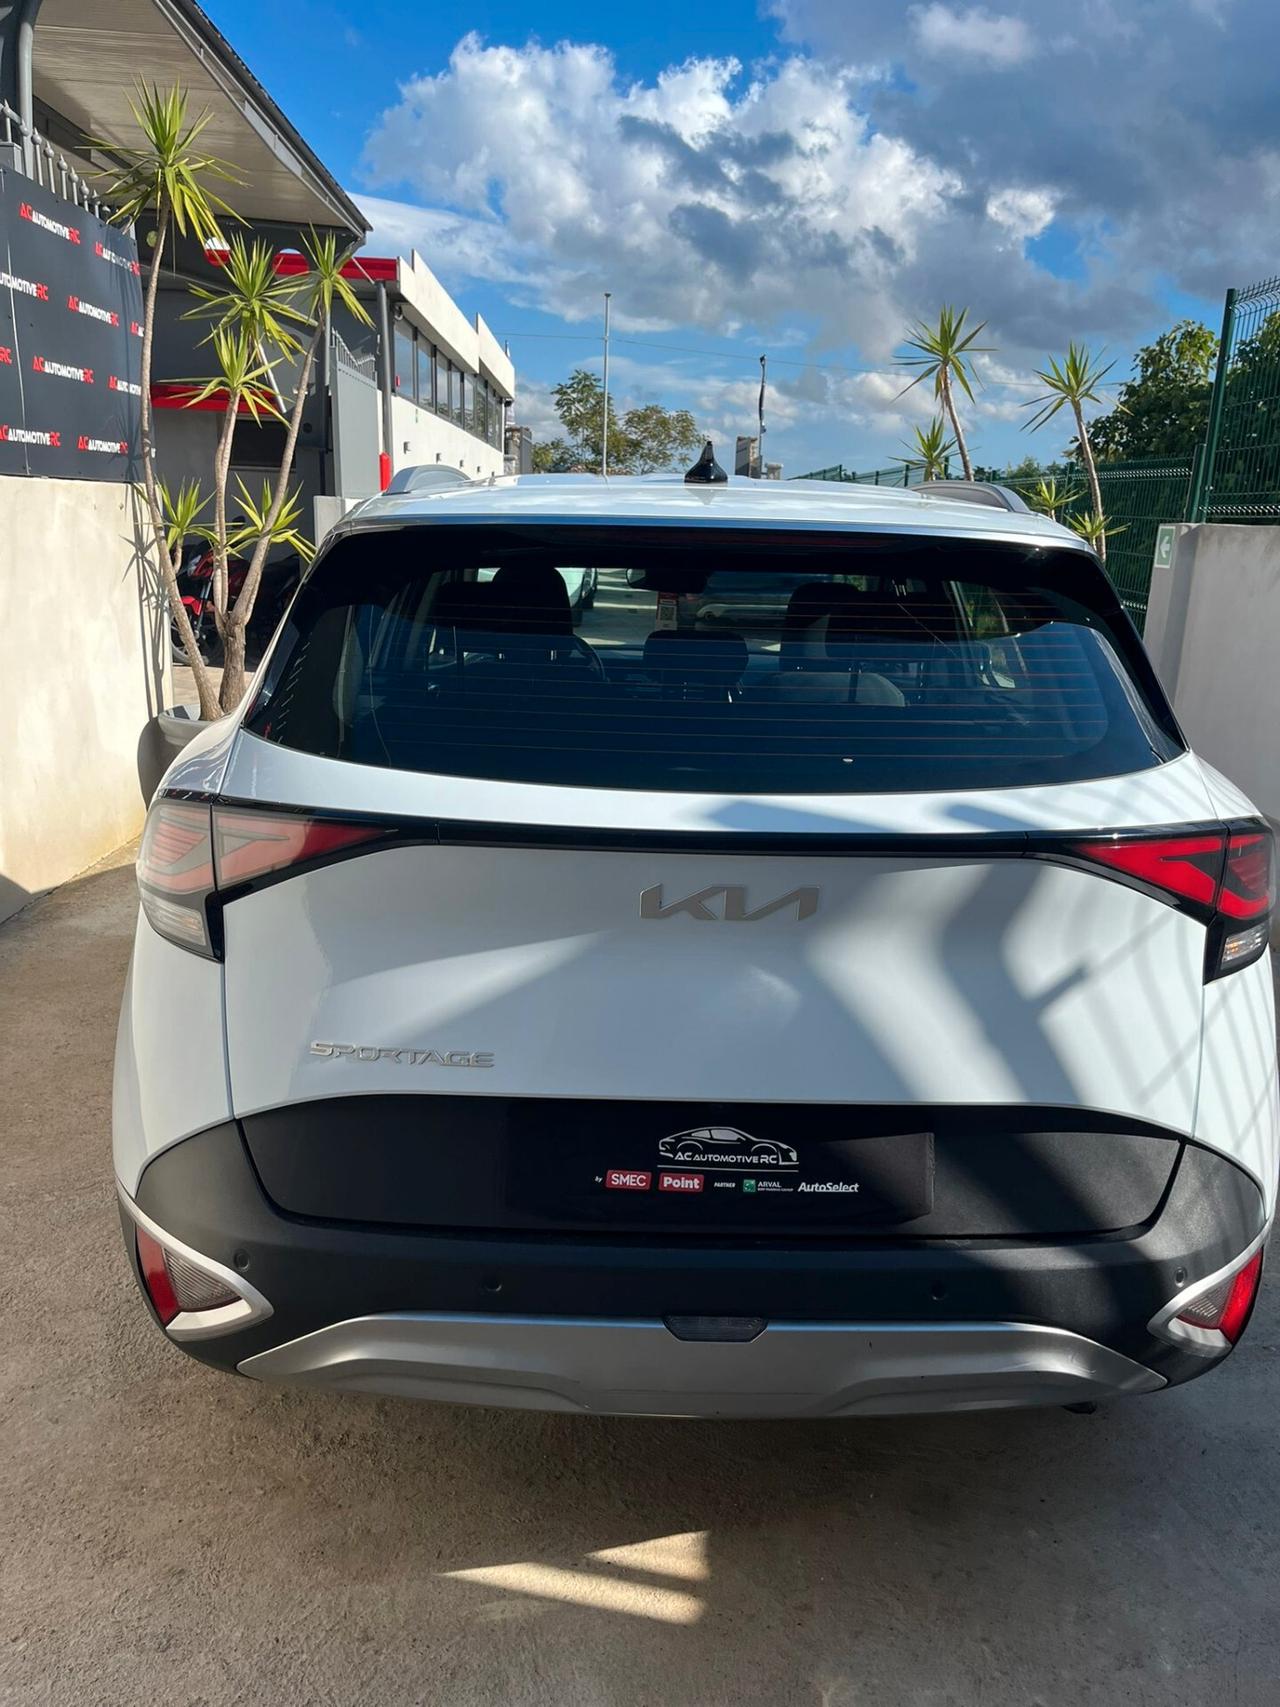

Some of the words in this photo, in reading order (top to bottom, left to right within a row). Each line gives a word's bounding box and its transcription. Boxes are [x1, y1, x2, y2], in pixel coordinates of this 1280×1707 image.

[639, 882, 820, 921] KIA
[309, 1041, 496, 1068] SPORTAGE
[611, 1173, 647, 1187] SMEC
[663, 1176, 700, 1189] Point
[798, 1181, 860, 1193] AutoSelect
